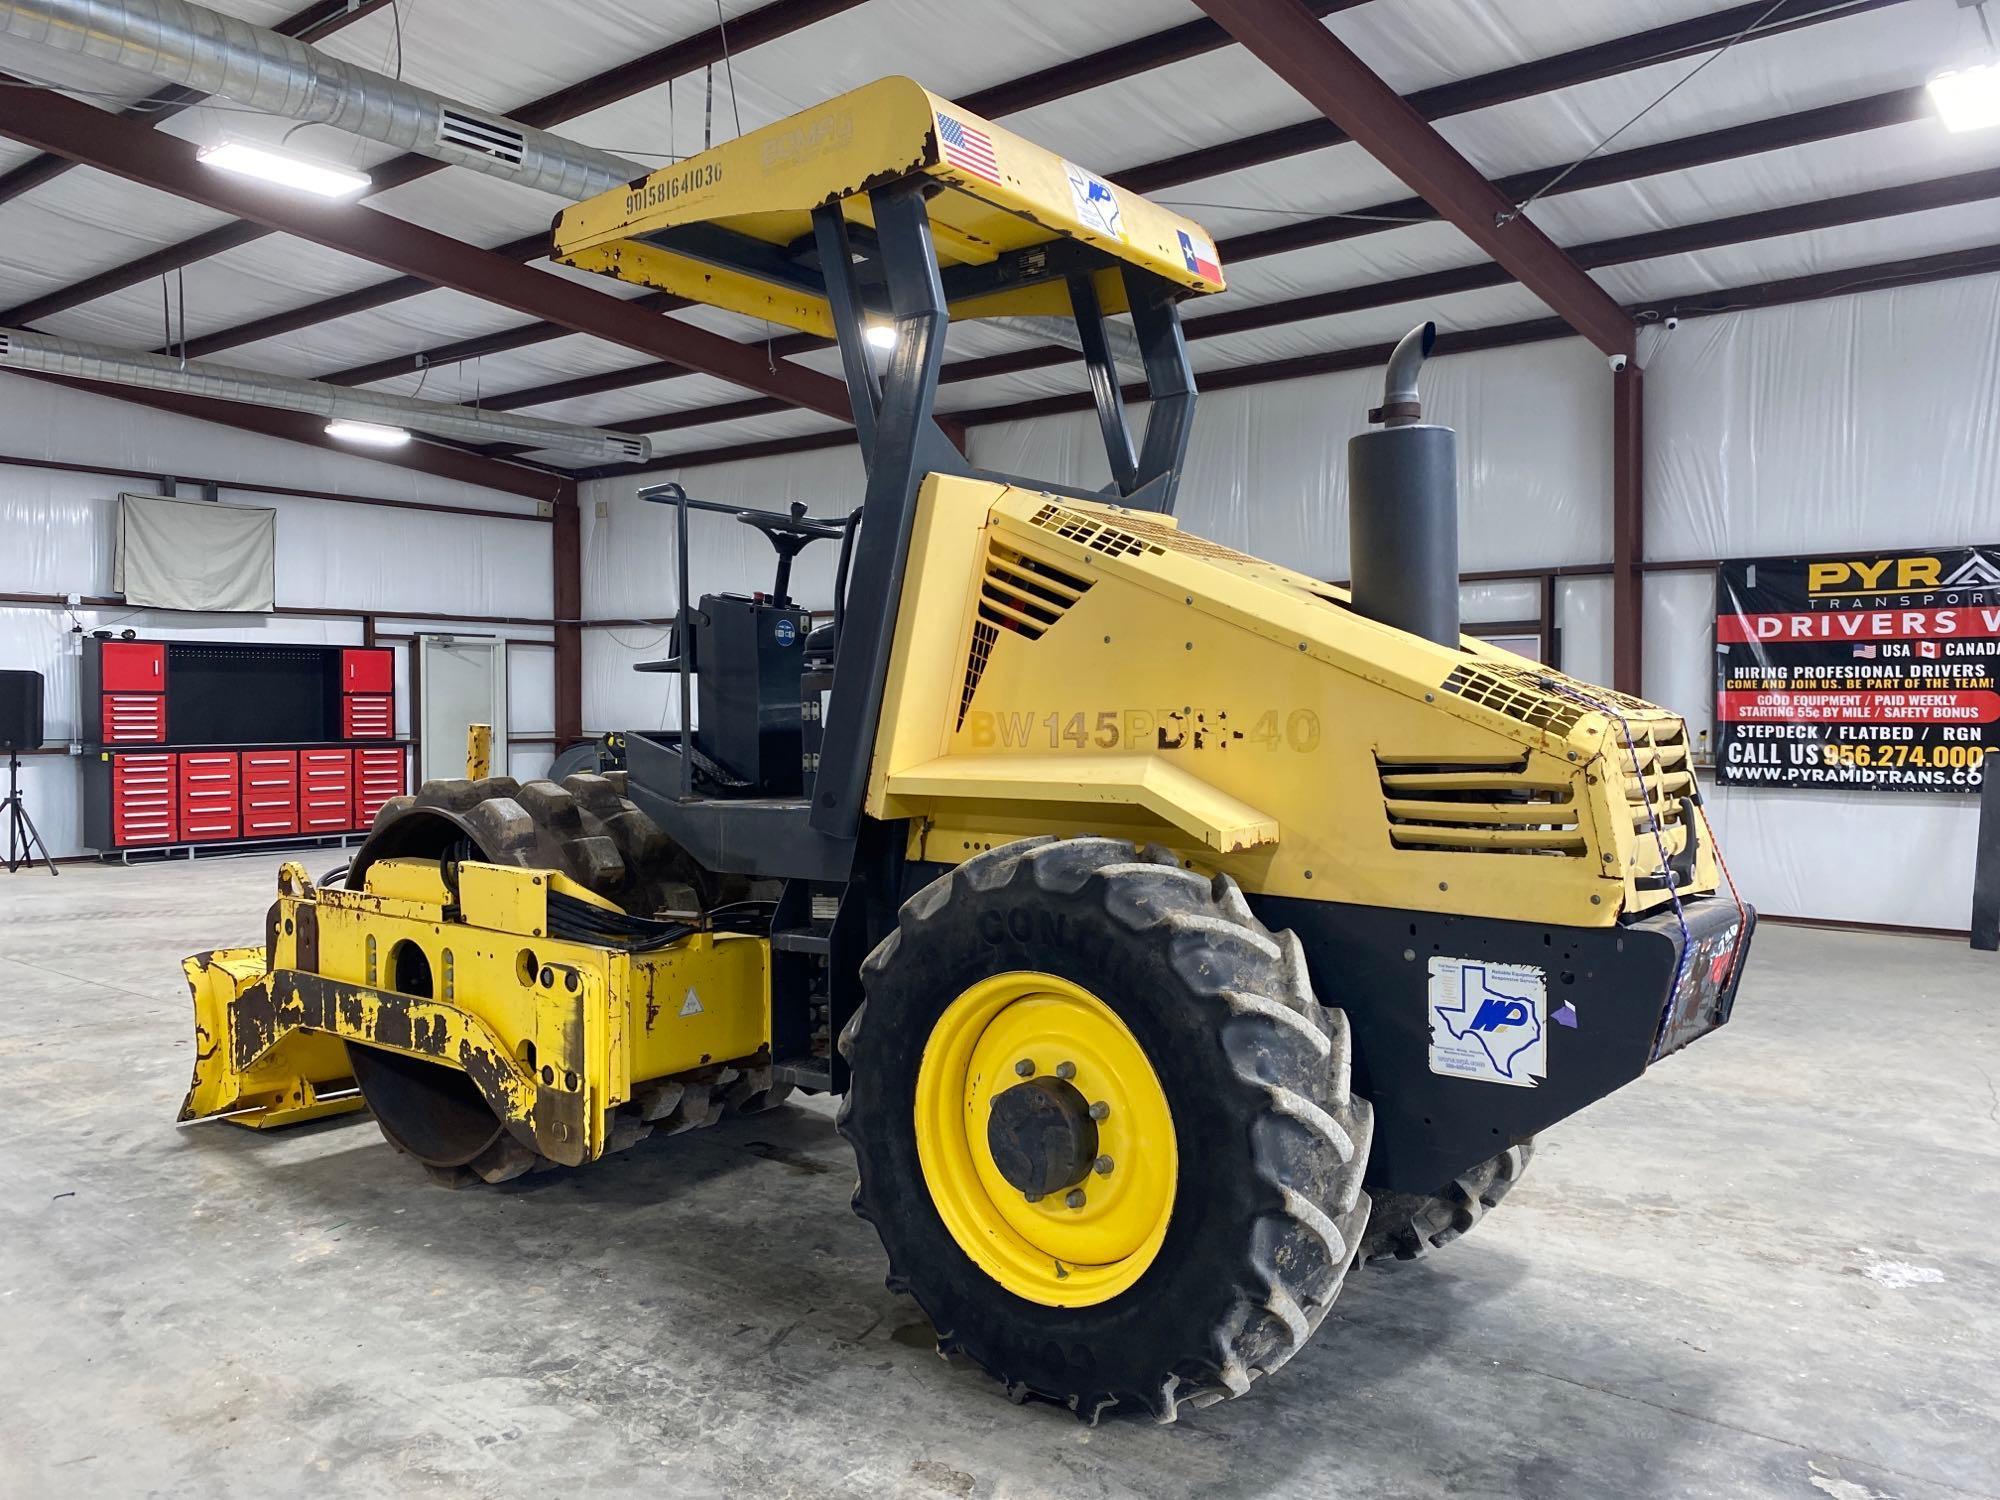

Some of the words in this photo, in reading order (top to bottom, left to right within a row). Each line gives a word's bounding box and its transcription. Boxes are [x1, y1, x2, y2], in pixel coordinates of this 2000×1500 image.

[1808, 592, 2000, 610] TRANSPOR
[1758, 610, 1957, 638] DRIVERS
[1882, 644, 1911, 657] USA
[1734, 666, 1788, 679] HIRING
[1794, 665, 1903, 679] PROFESIONAL
[1910, 664, 1986, 678] DRIVERS
[1726, 679, 1758, 689] COME
[1762, 680, 1786, 689] AND
[1790, 680, 1817, 689] JOIN
[1821, 679, 1842, 689] US.
[1846, 679, 1862, 689] BE
[1867, 679, 1899, 689] PART
[1904, 678, 1921, 689] OF
[1925, 678, 1949, 689] THE
[1955, 678, 1995, 689] TEAM!
[1757, 695, 1790, 706] GOOD
[1793, 695, 1861, 707] EQUIPMENT
[1874, 695, 1905, 706] PAID
[1908, 695, 1957, 706] WEEKLY
[1739, 706, 1794, 717] STARTING
[1823, 707, 1839, 717] BY
[1842, 707, 1871, 718] MILE
[1884, 707, 1929, 718] SAFETY
[1933, 707, 1979, 718] BONUS
[1736, 725, 1818, 739] STEPDECK
[1824, 726, 1832, 740] /
[1839, 727, 1914, 740] FLATBED
[1920, 727, 1929, 741] /
[1943, 727, 1982, 741] RGN
[1728, 742, 1782, 764] CALL
[1790, 743, 1819, 766] US
[1822, 744, 1999, 769] 956.274.000
